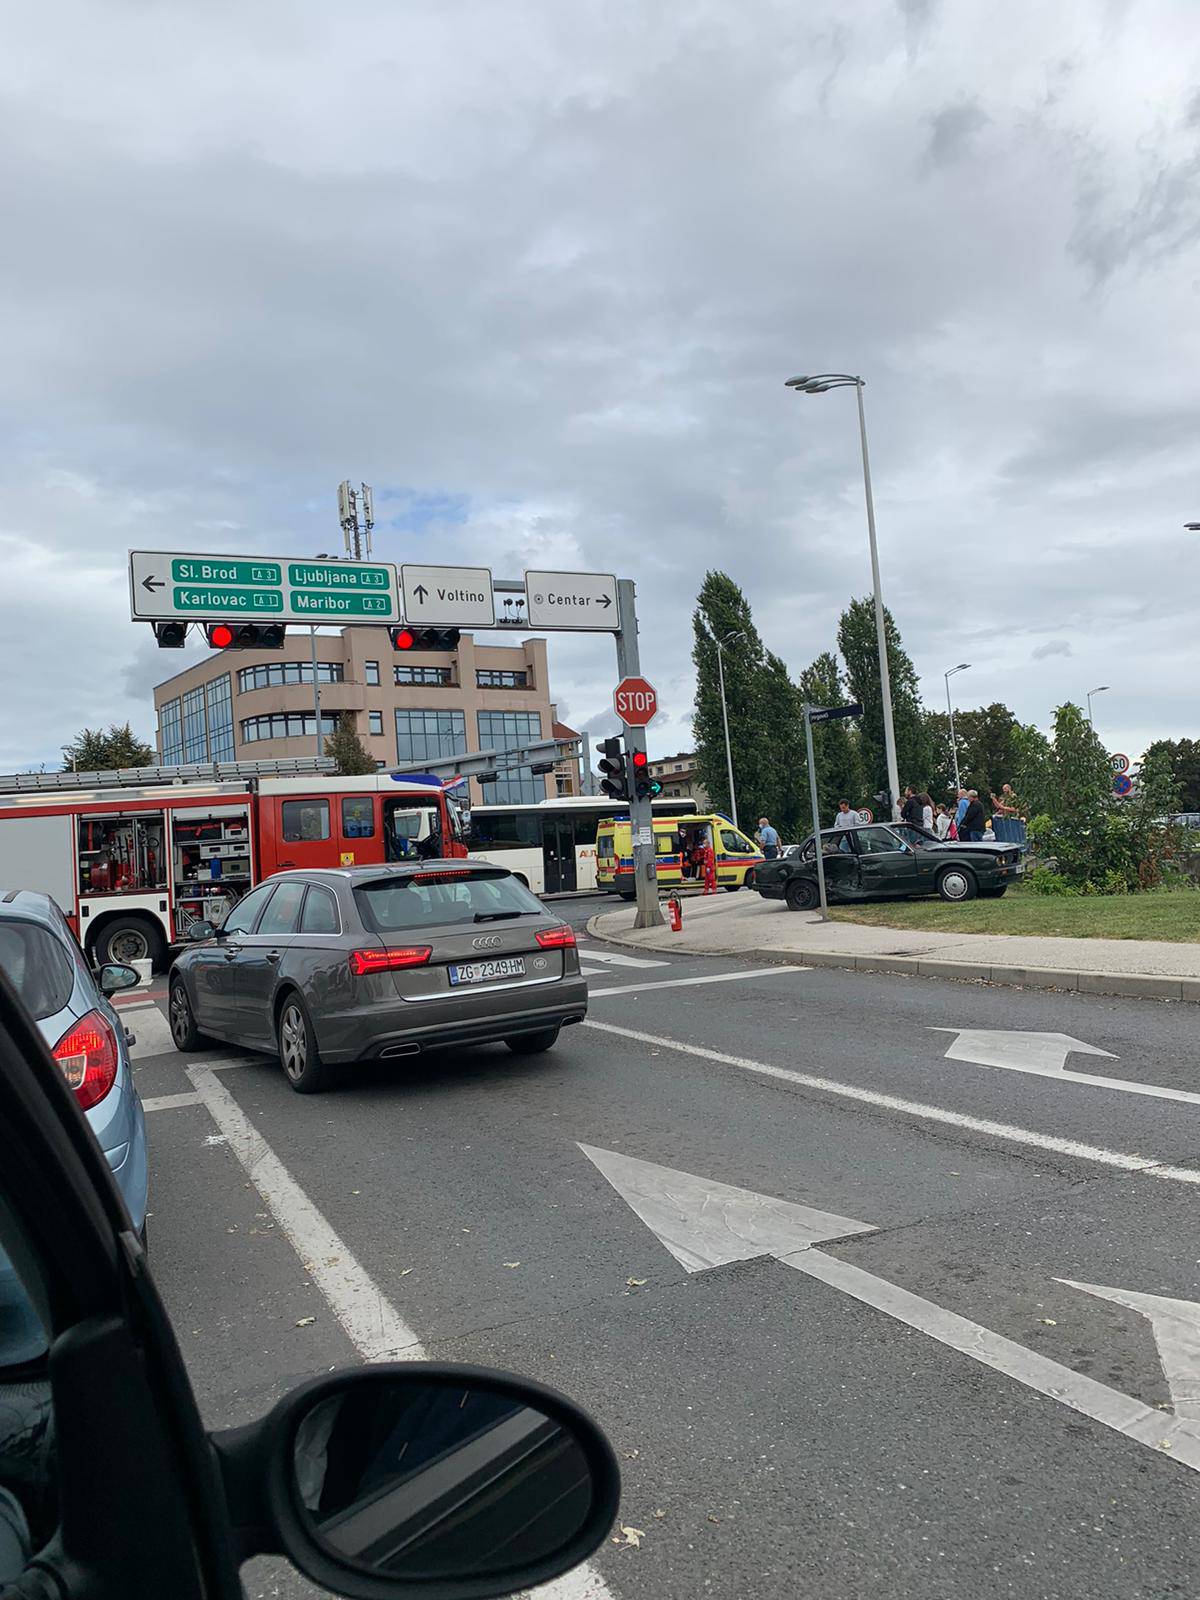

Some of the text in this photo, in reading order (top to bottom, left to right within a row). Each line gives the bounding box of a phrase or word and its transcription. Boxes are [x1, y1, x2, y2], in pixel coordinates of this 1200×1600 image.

[202, 565, 237, 579] Brod
[295, 568, 357, 585] Ljubljana
[180, 591, 247, 606] Karlovac
[437, 588, 485, 602] Voltino
[548, 593, 591, 606] Centar
[297, 595, 351, 610] Maribor
[617, 691, 655, 711] STOP
[1112, 758, 1126, 770] 60
[858, 812, 869, 823] 50
[458, 965, 474, 979] ZG
